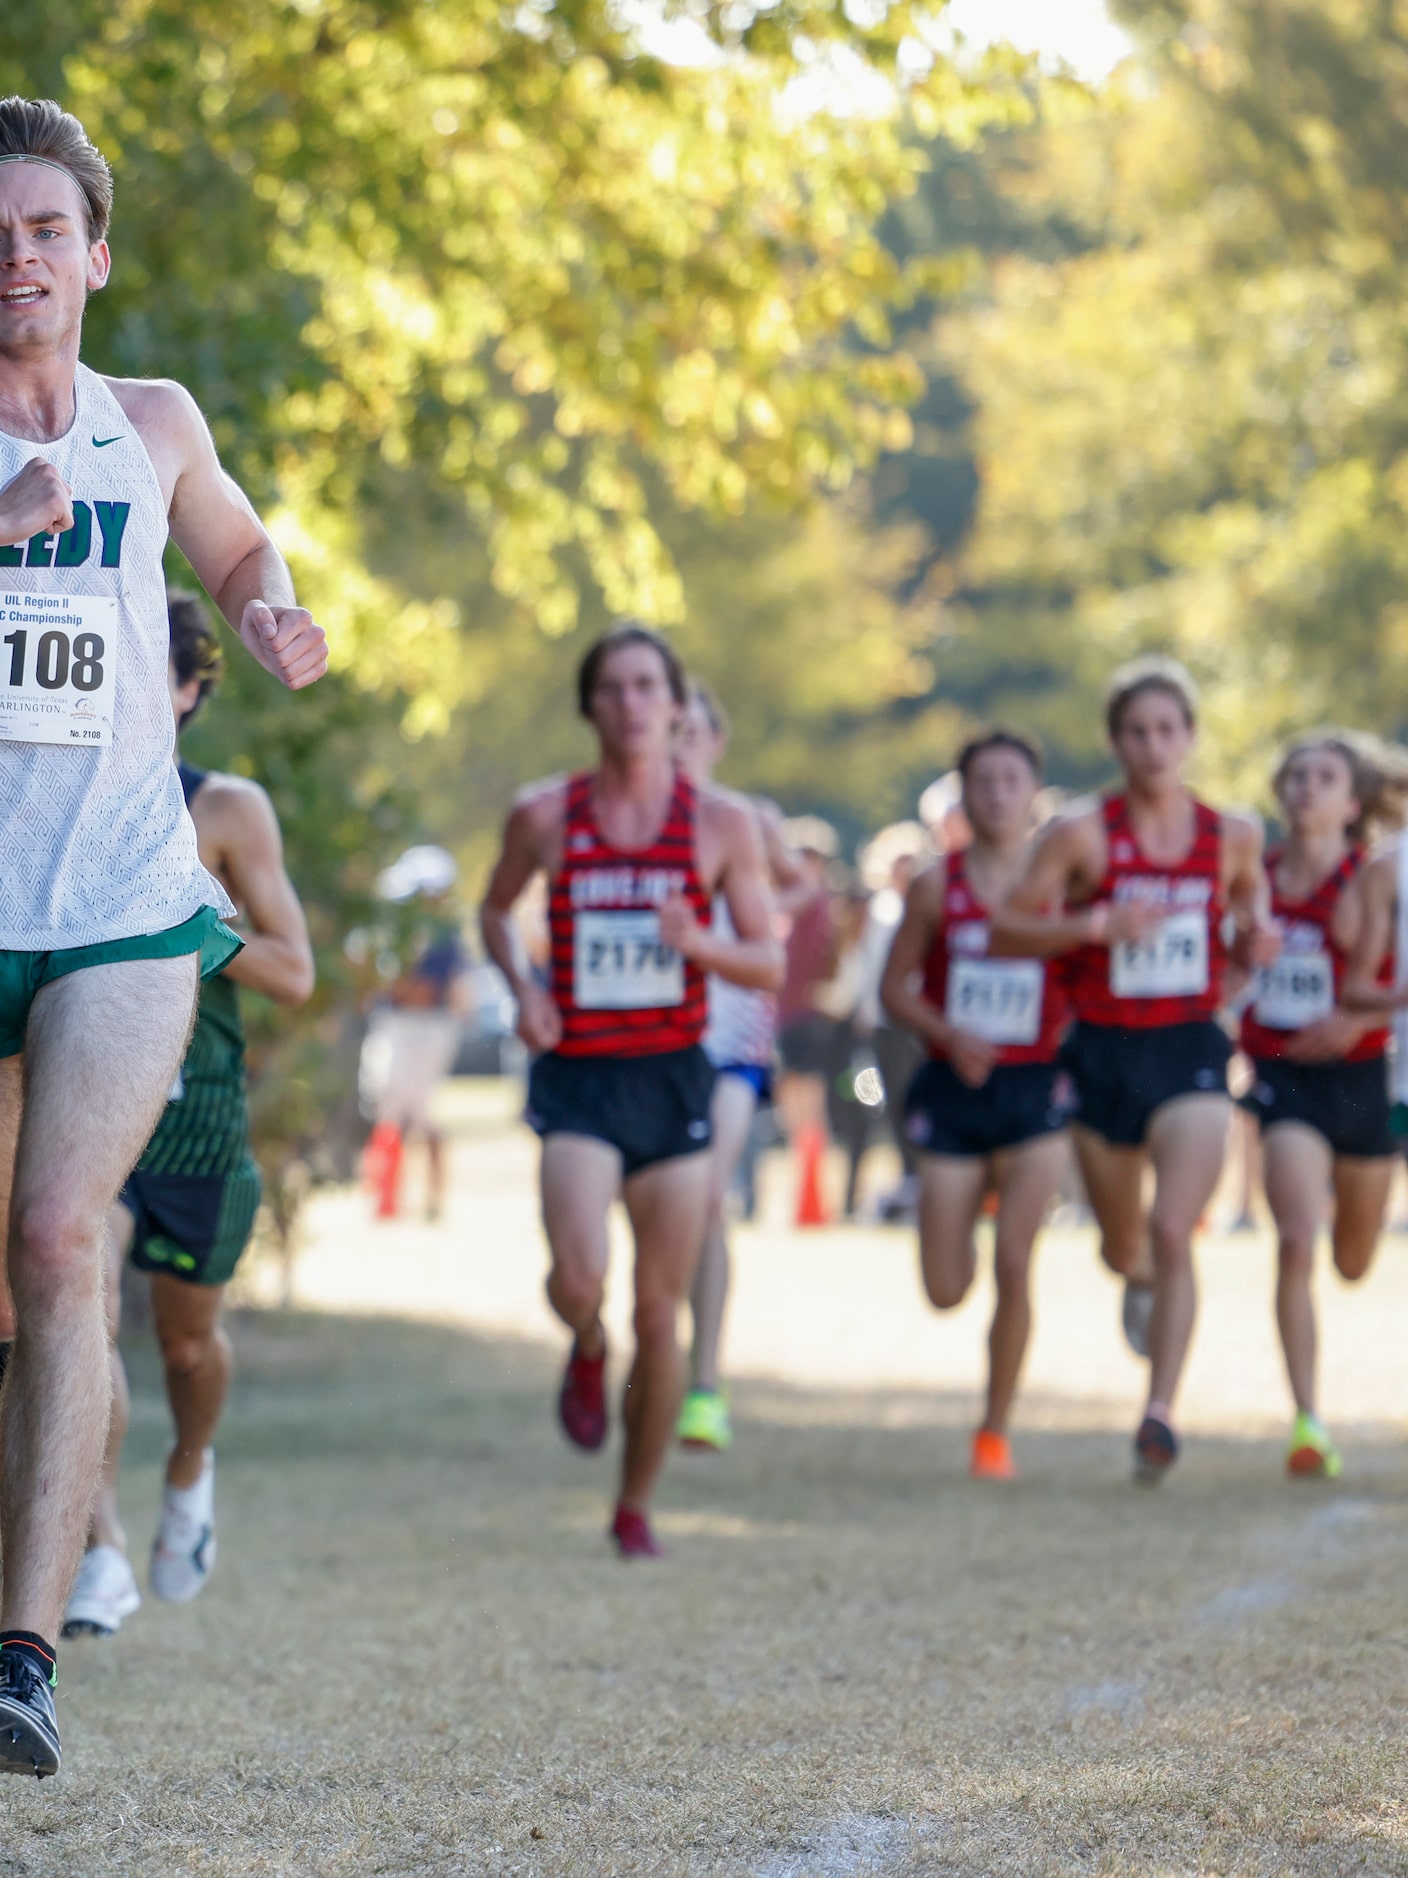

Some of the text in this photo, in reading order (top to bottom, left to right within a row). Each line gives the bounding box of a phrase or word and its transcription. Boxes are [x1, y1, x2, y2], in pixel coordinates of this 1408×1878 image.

[5, 595, 69, 609] UIL Region II
[9, 611, 83, 627] Championship
[7, 693, 39, 703] University
[41, 695, 49, 703] of
[51, 697, 69, 705] Texas
[70, 729, 101, 739] No. 2108
